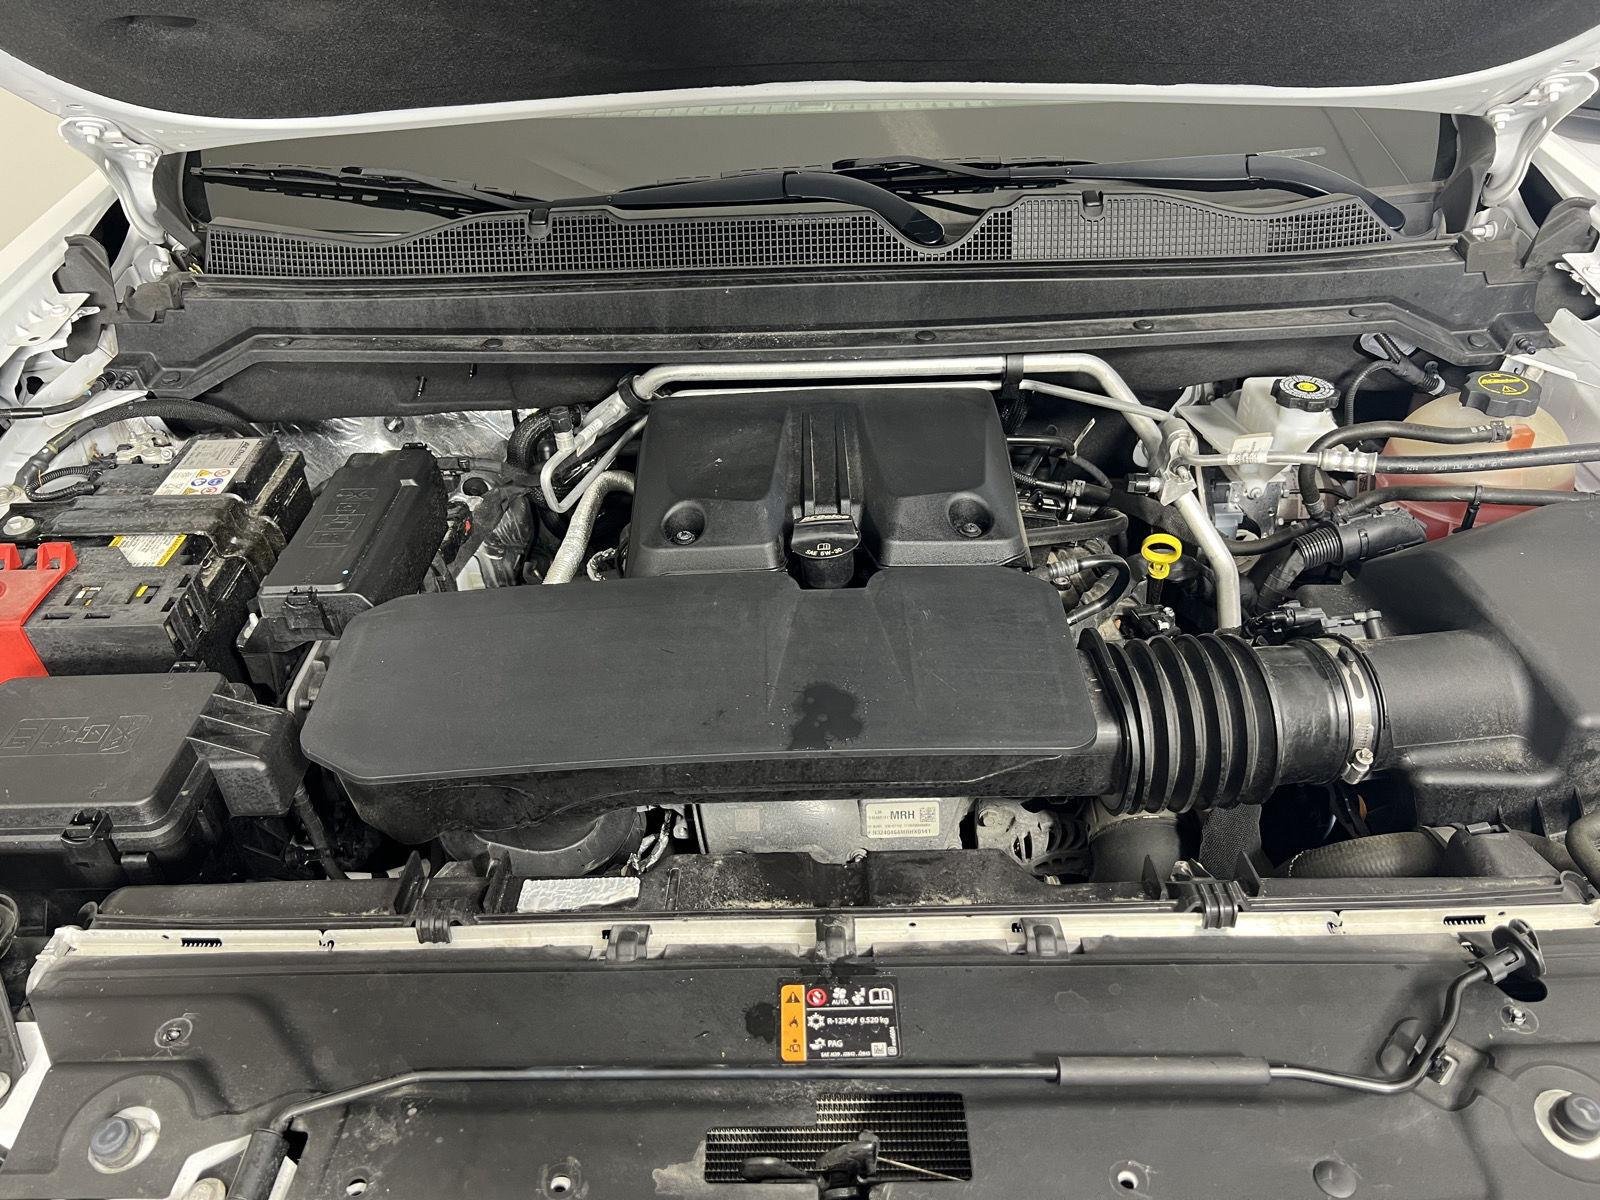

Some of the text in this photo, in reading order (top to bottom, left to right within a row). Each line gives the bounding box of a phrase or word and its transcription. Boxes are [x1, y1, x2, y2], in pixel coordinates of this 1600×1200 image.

[821, 548, 843, 556] 5W-30
[890, 810, 915, 820] MRH
[826, 1016, 889, 1026] R-1234yf 0.520 kg
[827, 1039, 844, 1048] PAG
